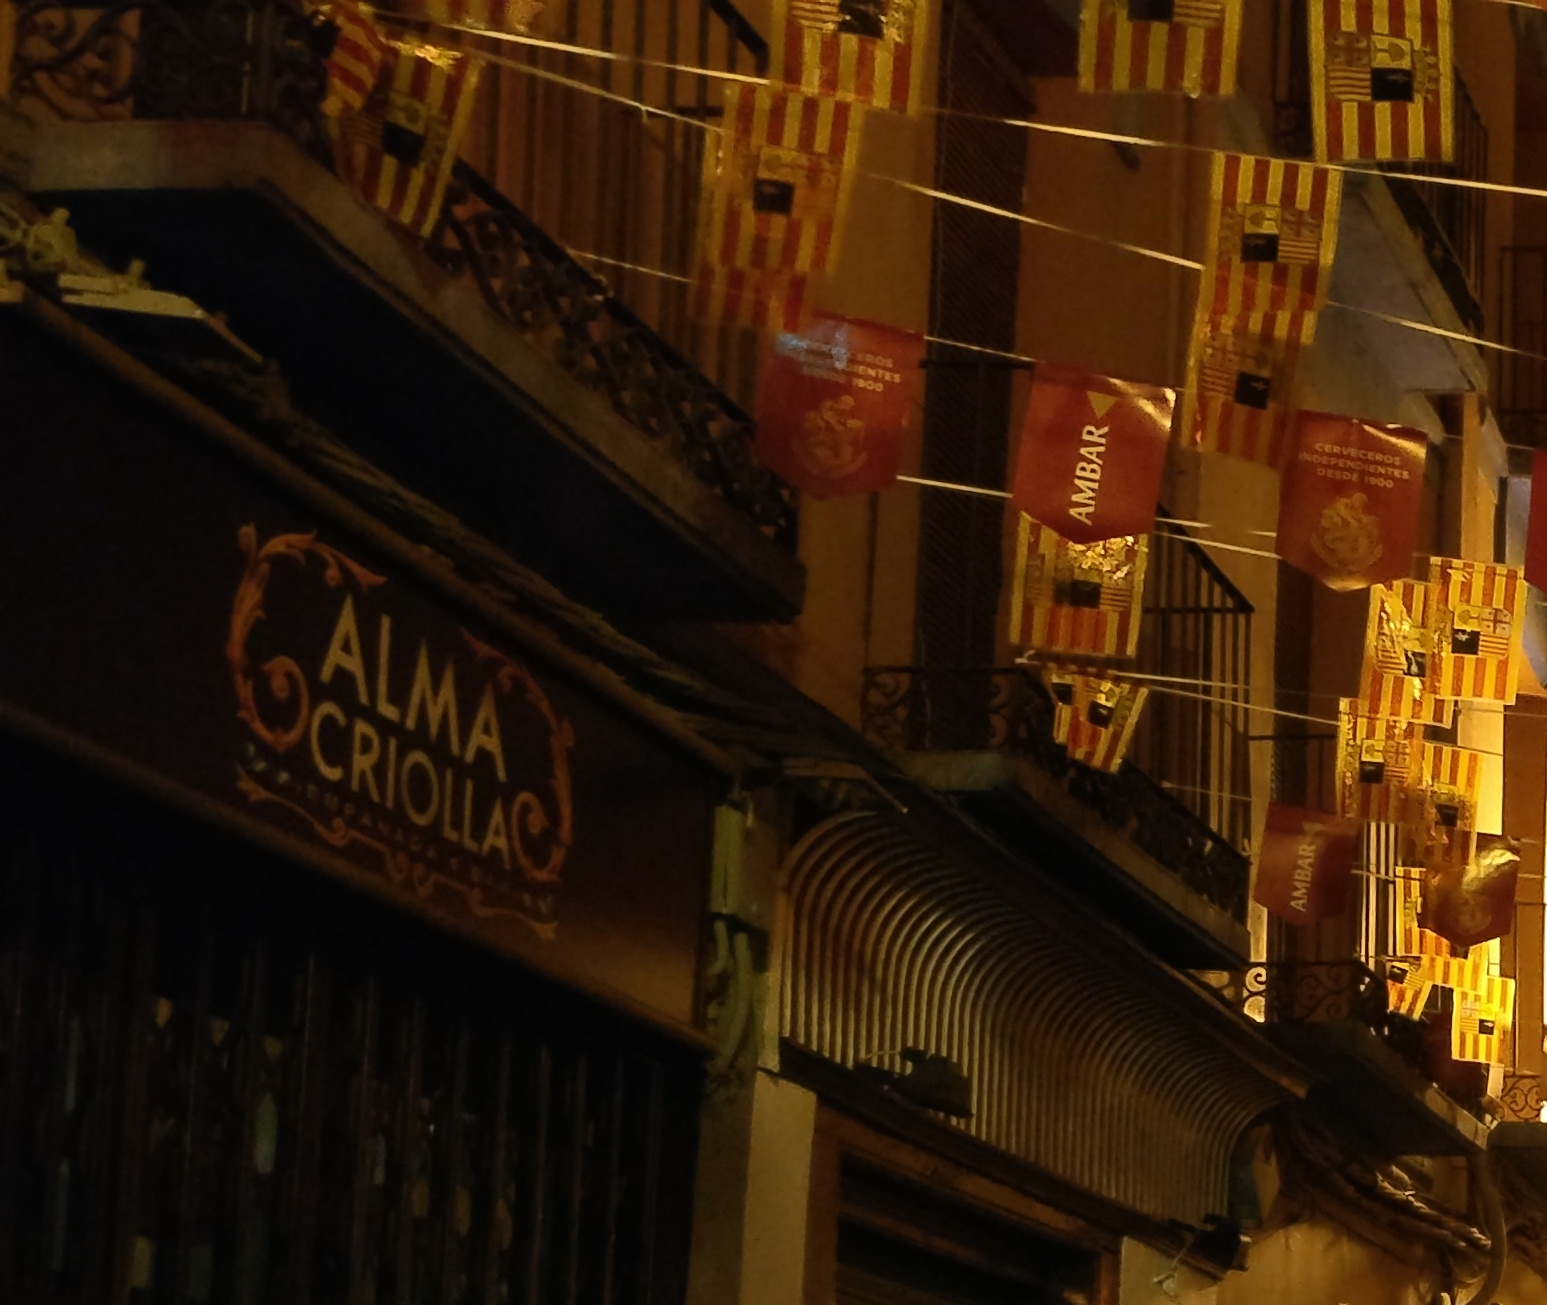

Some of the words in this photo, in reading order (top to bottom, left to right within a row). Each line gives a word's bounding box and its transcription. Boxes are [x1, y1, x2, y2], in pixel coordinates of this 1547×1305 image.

[1068, 425, 1110, 526] AMBAR
[1299, 452, 1410, 480] INDEPENDIENTES
[1314, 442, 1401, 466] CERVECEROS
[1316, 467, 1360, 482] DESDE
[1364, 474, 1394, 489] 1900
[320, 593, 508, 783] ALMA
[310, 700, 513, 871] CRIOLLA
[1290, 844, 1317, 912] AMBAR
